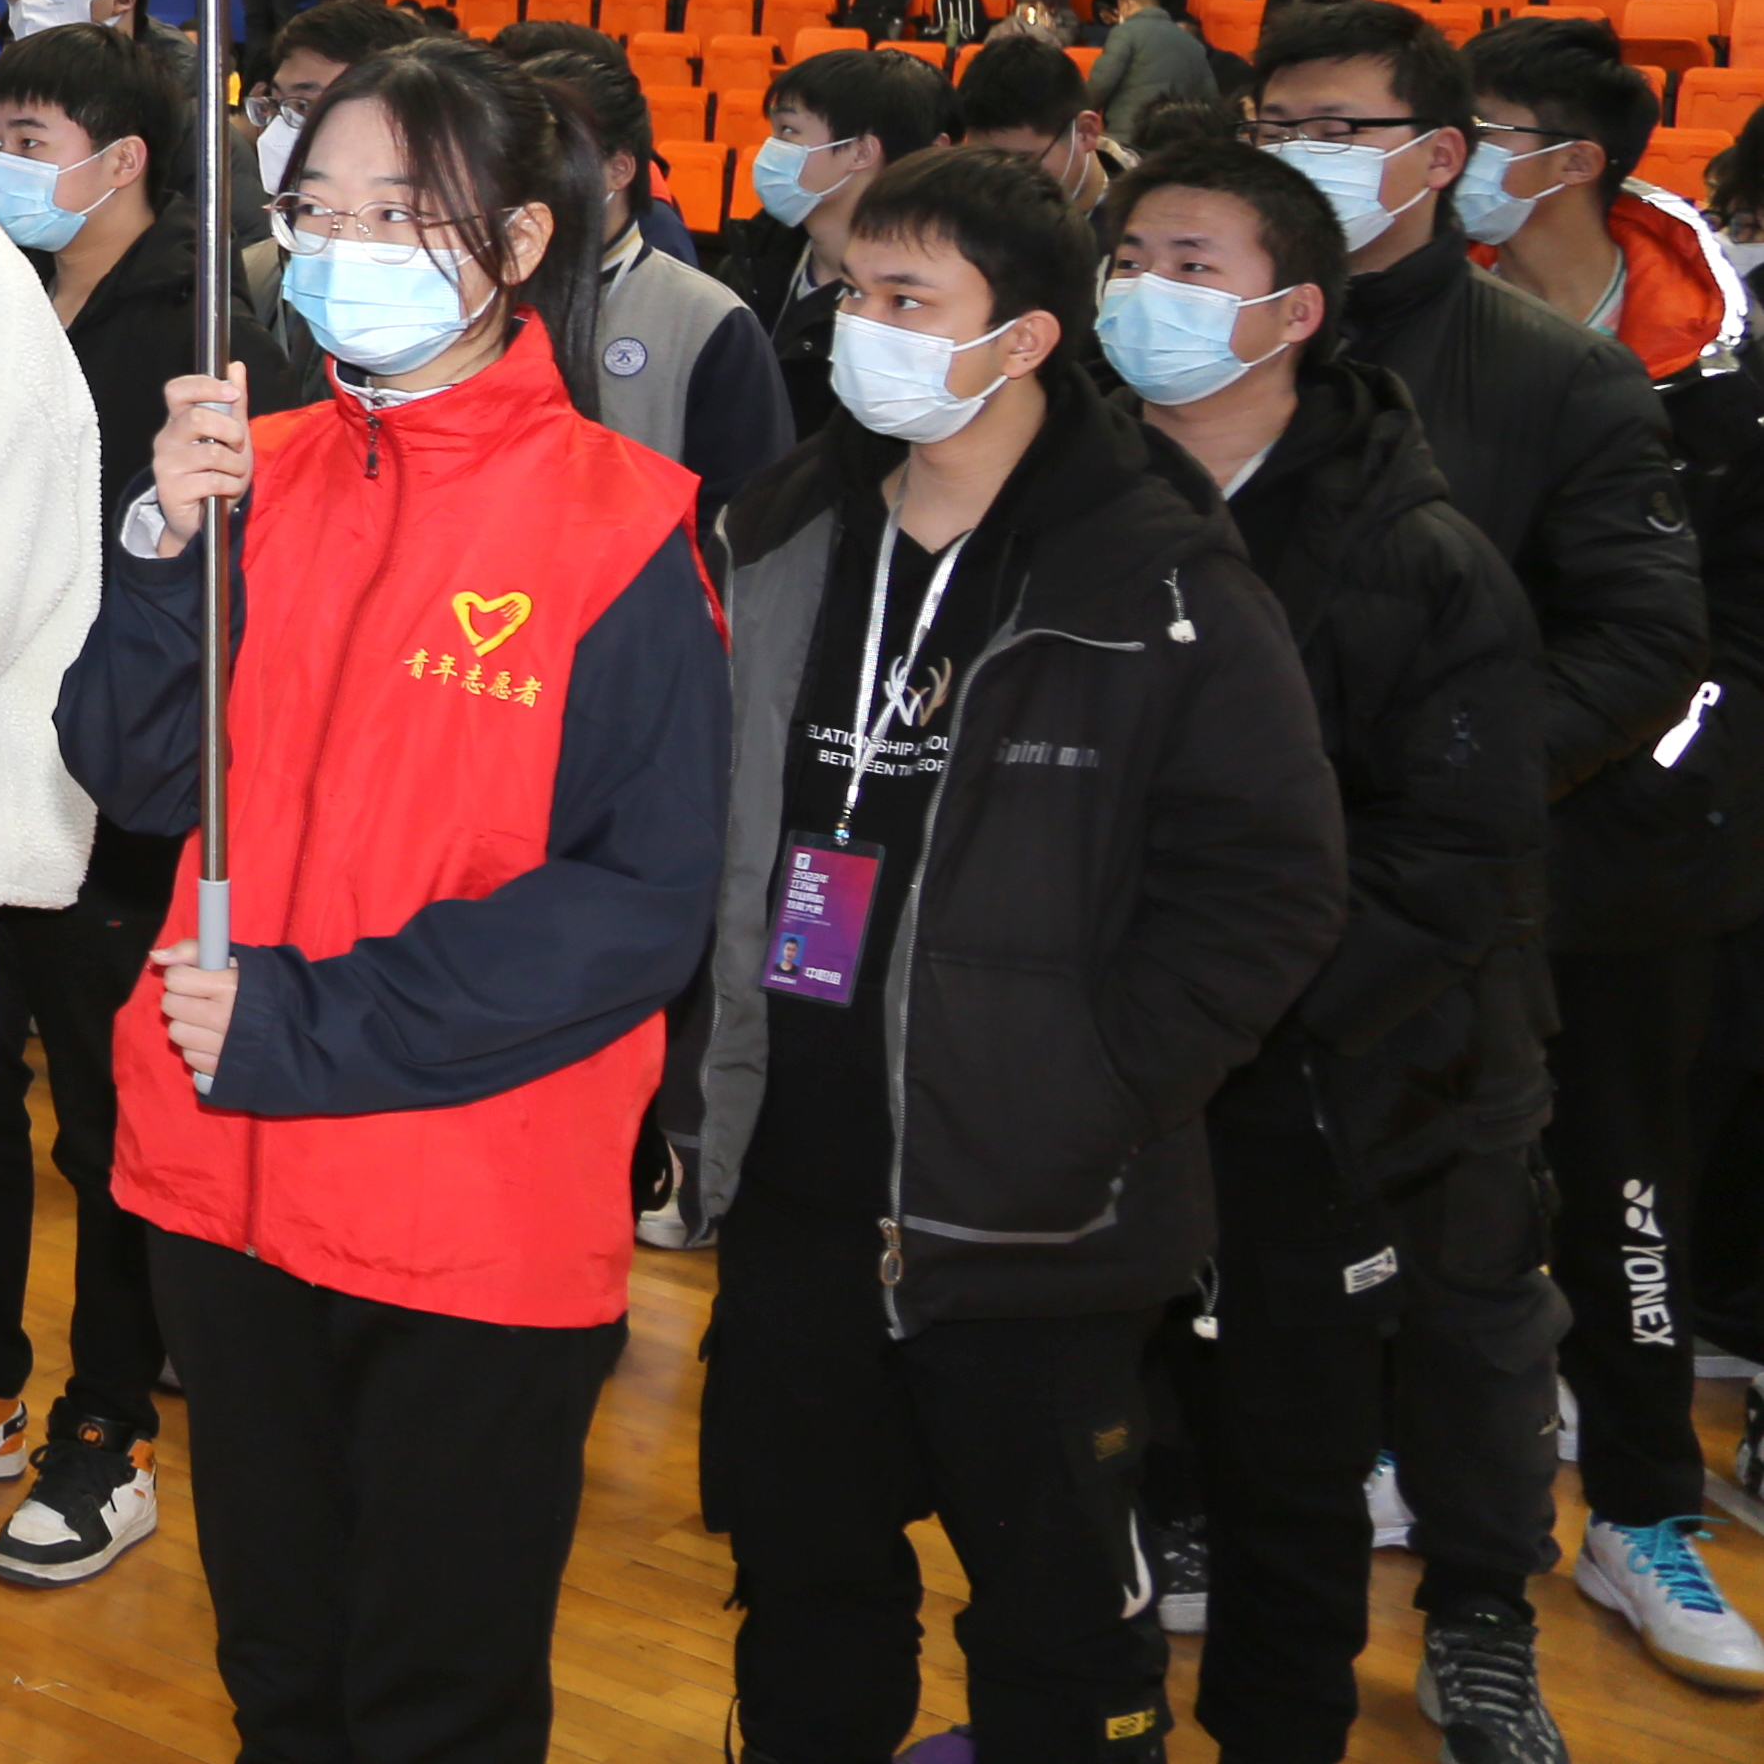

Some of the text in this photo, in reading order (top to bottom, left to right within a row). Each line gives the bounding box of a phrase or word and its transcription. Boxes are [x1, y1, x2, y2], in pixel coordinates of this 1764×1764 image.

[403, 648, 542, 708] 青年志愿者
[1621, 1244, 1675, 1346] YONEX
